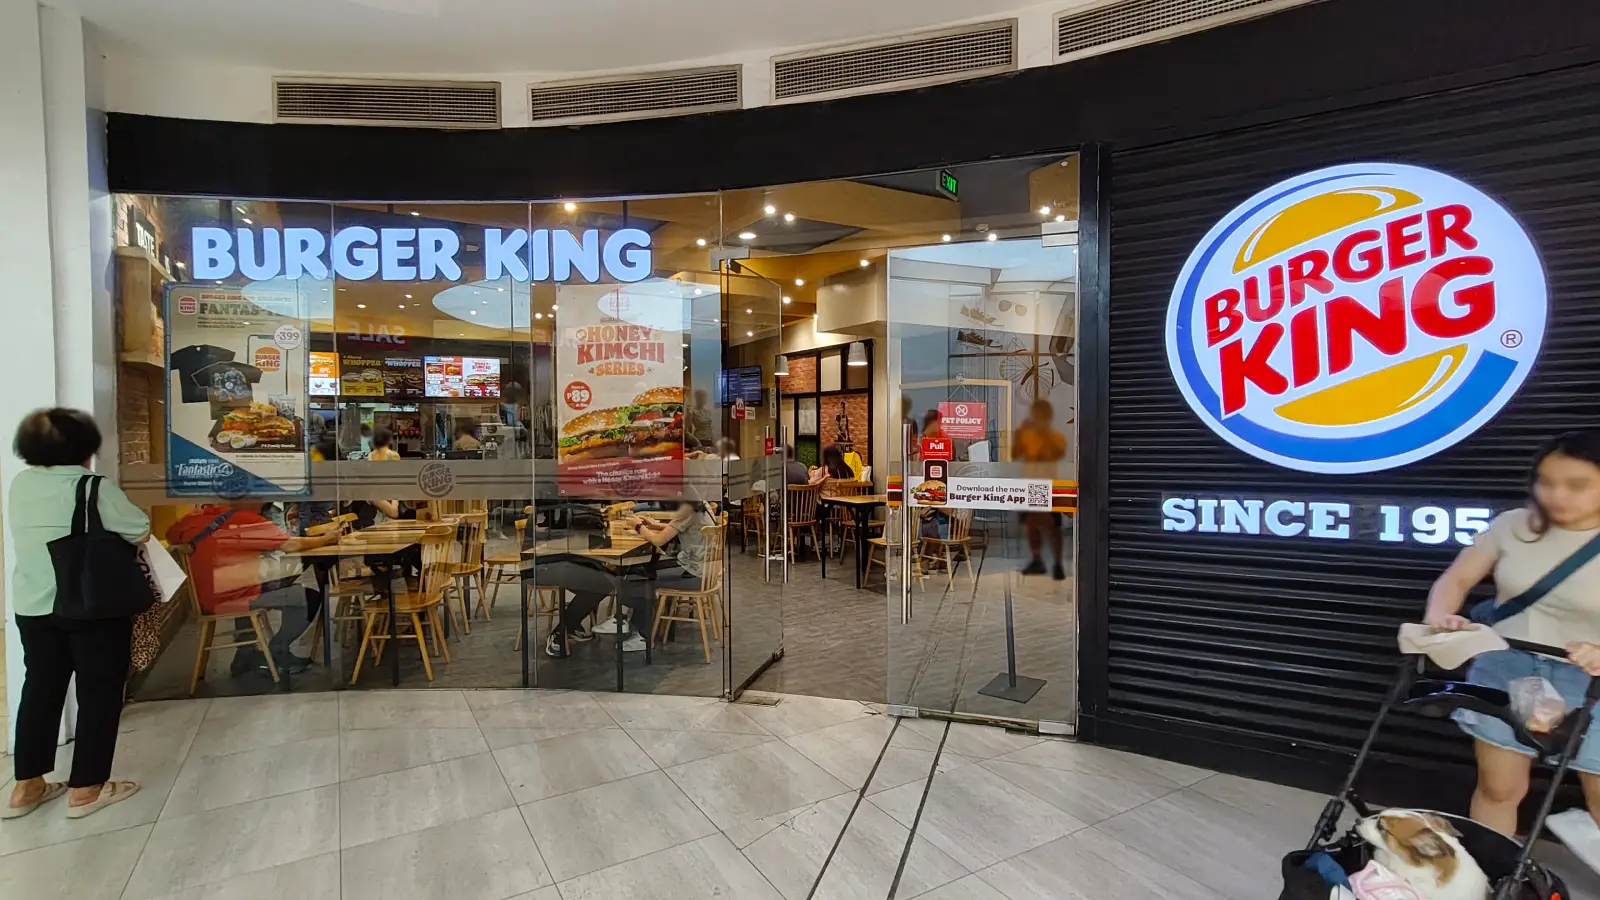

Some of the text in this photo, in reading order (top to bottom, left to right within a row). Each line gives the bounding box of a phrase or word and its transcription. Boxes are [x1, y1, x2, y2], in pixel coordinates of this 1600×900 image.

[942, 173, 957, 194] EXIT
[135, 222, 155, 259] TASTE
[192, 226, 652, 283] BURGER KING
[1204, 203, 1479, 348] BURGER
[586, 325, 653, 342] HONEY
[1218, 255, 1496, 417] KING
[577, 342, 665, 365] KIMCHI
[255, 359, 281, 368] KING
[595, 362, 645, 376] SERIES
[929, 442, 944, 450] Pull
[423, 474, 453, 490] KING
[956, 484, 994, 492] Download
[949, 493, 1026, 504] Burger King App
[1162, 497, 1491, 547] SINCE 195
